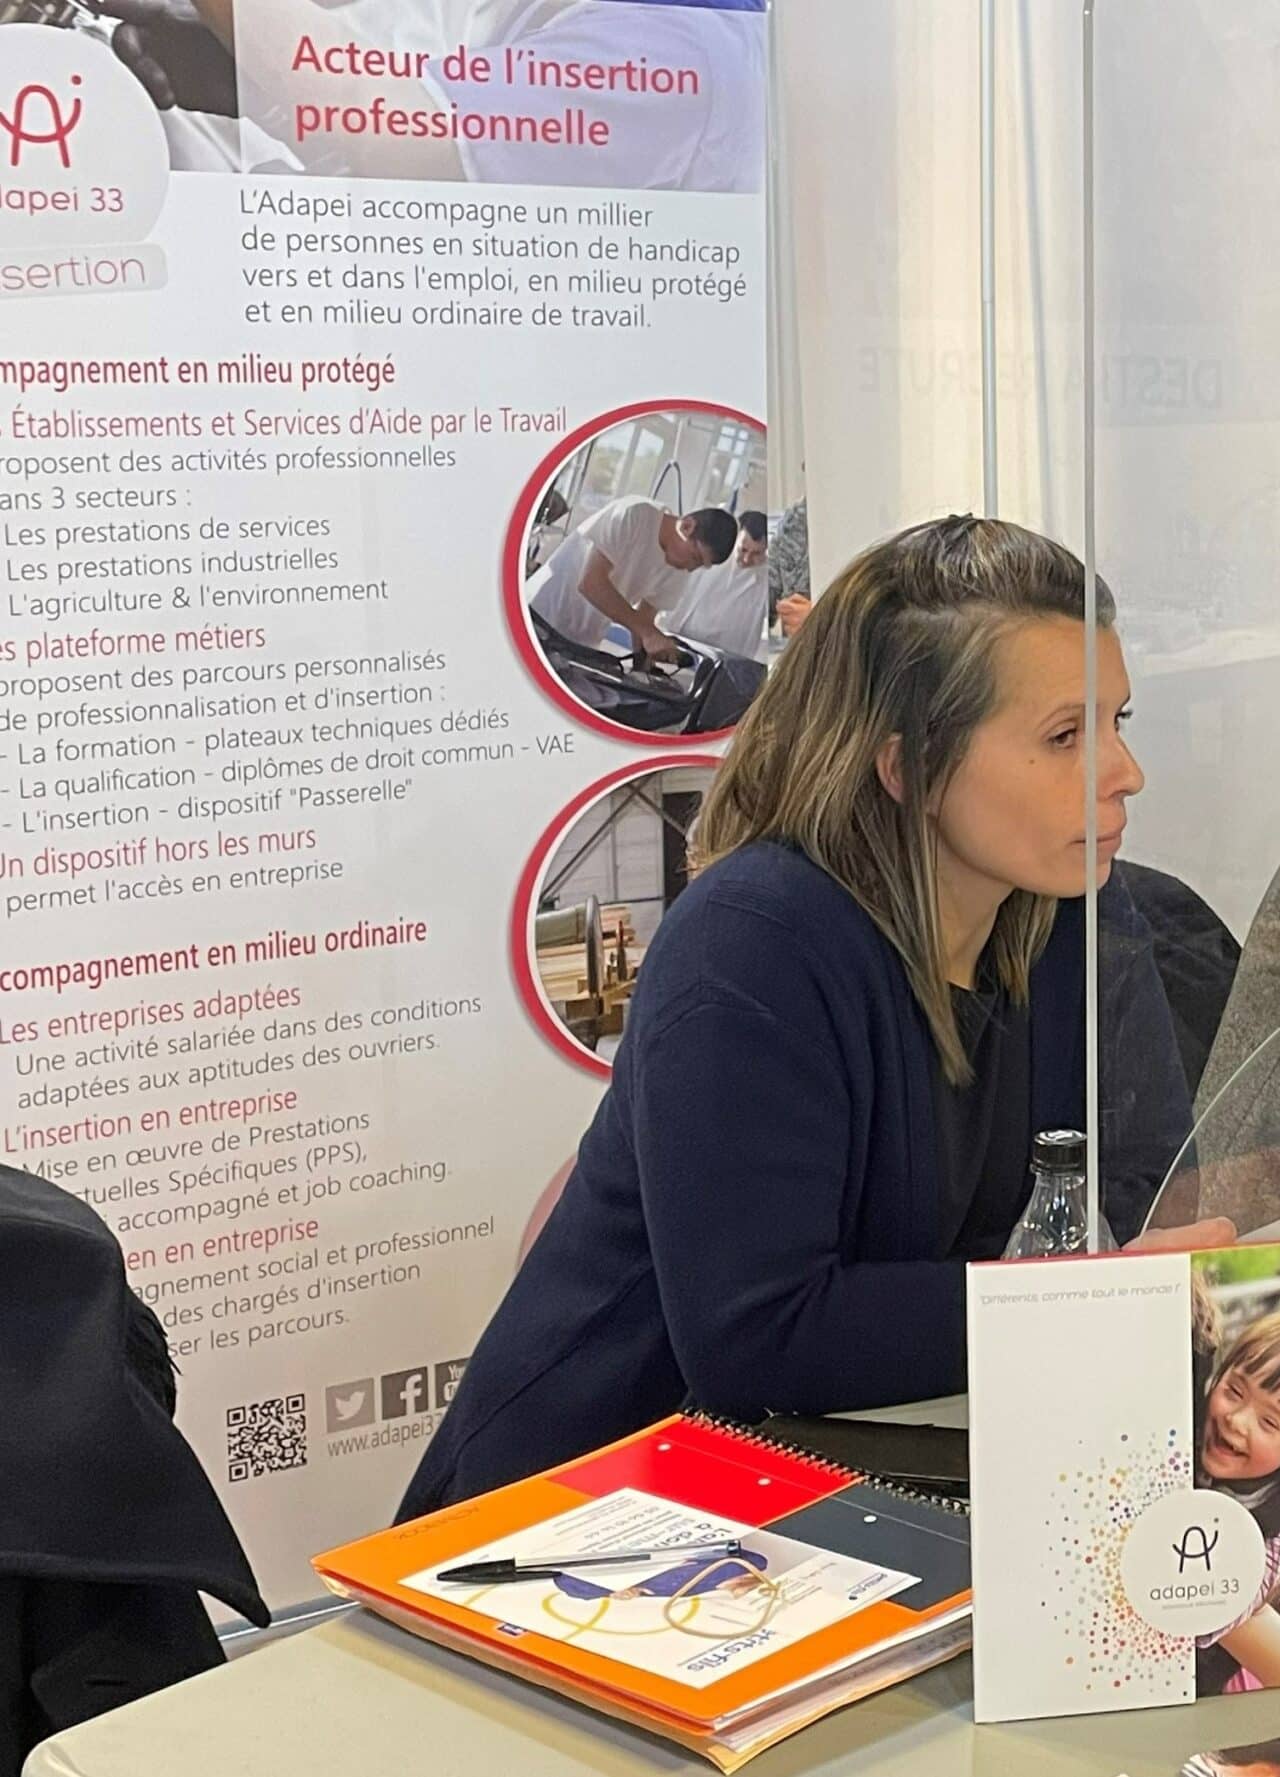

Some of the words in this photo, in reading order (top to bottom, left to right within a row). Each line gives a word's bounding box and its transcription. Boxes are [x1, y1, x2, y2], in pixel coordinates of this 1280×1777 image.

[292, 35, 430, 78] Acteur
[443, 44, 491, 82] de
[506, 48, 698, 94] l'insertion
[296, 97, 609, 146] professionnelle
[0, 184, 78, 216] apei
[90, 187, 124, 212] 33
[240, 189, 351, 224] L'Adapei
[362, 200, 527, 229] accompagne
[537, 207, 567, 224] un
[578, 202, 653, 227] millier
[241, 224, 275, 251] de
[286, 233, 424, 259] personnes
[433, 237, 463, 256] en
[472, 232, 578, 258] situation
[588, 235, 619, 260] de
[629, 236, 740, 270] handicap
[242, 268, 298, 287] vers
[307, 266, 333, 288] et
[342, 263, 405, 289] dans
[415, 264, 518, 297] l'emploi,
[528, 274, 558, 292] en
[569, 269, 641, 294] milieu
[652, 272, 746, 303] protégé
[245, 301, 272, 323] et
[281, 305, 312, 323] en
[324, 298, 401, 324] milieu
[412, 300, 523, 326] ordinaire
[532, 302, 562, 326] de
[571, 304, 650, 327] travail.
[178, 362, 208, 383] en
[218, 353, 292, 383] milieu
[302, 353, 395, 392] protégé
[12, 404, 202, 439] Établissements
[211, 412, 236, 436] et
[244, 408, 341, 436] Services
[349, 407, 422, 435] d'Aide
[431, 414, 466, 441] par
[474, 407, 492, 433] le
[499, 406, 566, 432] Travail
[5, 523, 46, 546] Les
[56, 519, 190, 551] prestations
[199, 516, 230, 540] de
[239, 516, 330, 538] services
[7, 559, 48, 581] Les
[57, 554, 192, 586] prestations
[201, 547, 338, 573] industrielles
[9, 589, 162, 621] L'agriculture
[172, 586, 191, 608] &
[200, 580, 388, 607] l'environnement
[131, 664, 173, 688] des
[183, 663, 286, 692] parcours
[295, 649, 446, 684] personnalisés
[0, 708, 27, 732] de
[37, 693, 276, 735] professionnalisation
[285, 692, 307, 711] et
[314, 683, 432, 709] d'insertion
[18, 743, 46, 765] La
[56, 734, 175, 762] formation
[205, 727, 303, 757] plateaux
[311, 717, 432, 743] techniques
[440, 708, 509, 733] dédiés
[20, 778, 46, 799] La
[54, 766, 195, 802] qualification
[222, 756, 324, 787] diplômes
[330, 751, 358, 773] de
[365, 747, 415, 770] droit
[421, 743, 513, 766] commun
[536, 733, 574, 755] VAE
[23, 803, 149, 833] L'insertion
[178, 788, 282, 822] dispositif
[290, 779, 412, 808] "Passerelle"
[34, 836, 147, 880] dispositif
[155, 837, 209, 863] hors
[218, 830, 249, 857] les
[259, 829, 316, 853] murs
[6, 884, 96, 919] permet
[105, 874, 184, 901] l'accès
[192, 875, 221, 892] en
[230, 859, 343, 888] entreprise
[0, 944, 199, 994] compagnement
[207, 945, 236, 966] en
[245, 930, 316, 963] milieu
[325, 917, 427, 952] ordinaire
[0, 1020, 39, 1045] Les
[48, 1000, 184, 1038] entreprises
[193, 983, 301, 1021] adaptées
[16, 1053, 65, 1076] Une
[75, 1035, 159, 1068] activité
[167, 1024, 255, 1055] salariée
[263, 1019, 317, 1041] dans
[324, 1011, 363, 1032] des
[371, 998, 481, 1026] conditions
[18, 1075, 129, 1109] adaptées
[138, 1071, 180, 1091] aux
[188, 1052, 294, 1088] aptitudes
[302, 1044, 341, 1067] des
[348, 1034, 440, 1060] ouvriers.
[4, 1114, 131, 1153] L'insertion
[140, 1110, 170, 1132] en
[179, 1088, 297, 1126] entreprise
[87, 1154, 116, 1172] en
[125, 1140, 203, 1167] œuvre
[211, 1130, 240, 1153] de
[249, 1114, 369, 1147] Prestations
[118, 1186, 269, 1232] accompagné
[277, 1184, 299, 1204] et
[303, 1175, 341, 1206] job
[349, 1162, 451, 1192] coaching.
[165, 1242, 194, 1264] en
[203, 1218, 318, 1257] entreprise
[163, 1306, 204, 1328] des
[211, 1284, 299, 1318] chargés
[307, 1264, 420, 1300] d'insertion
[1150, 1580, 1215, 1601] adapei
[1220, 1577, 1240, 1595] 33
